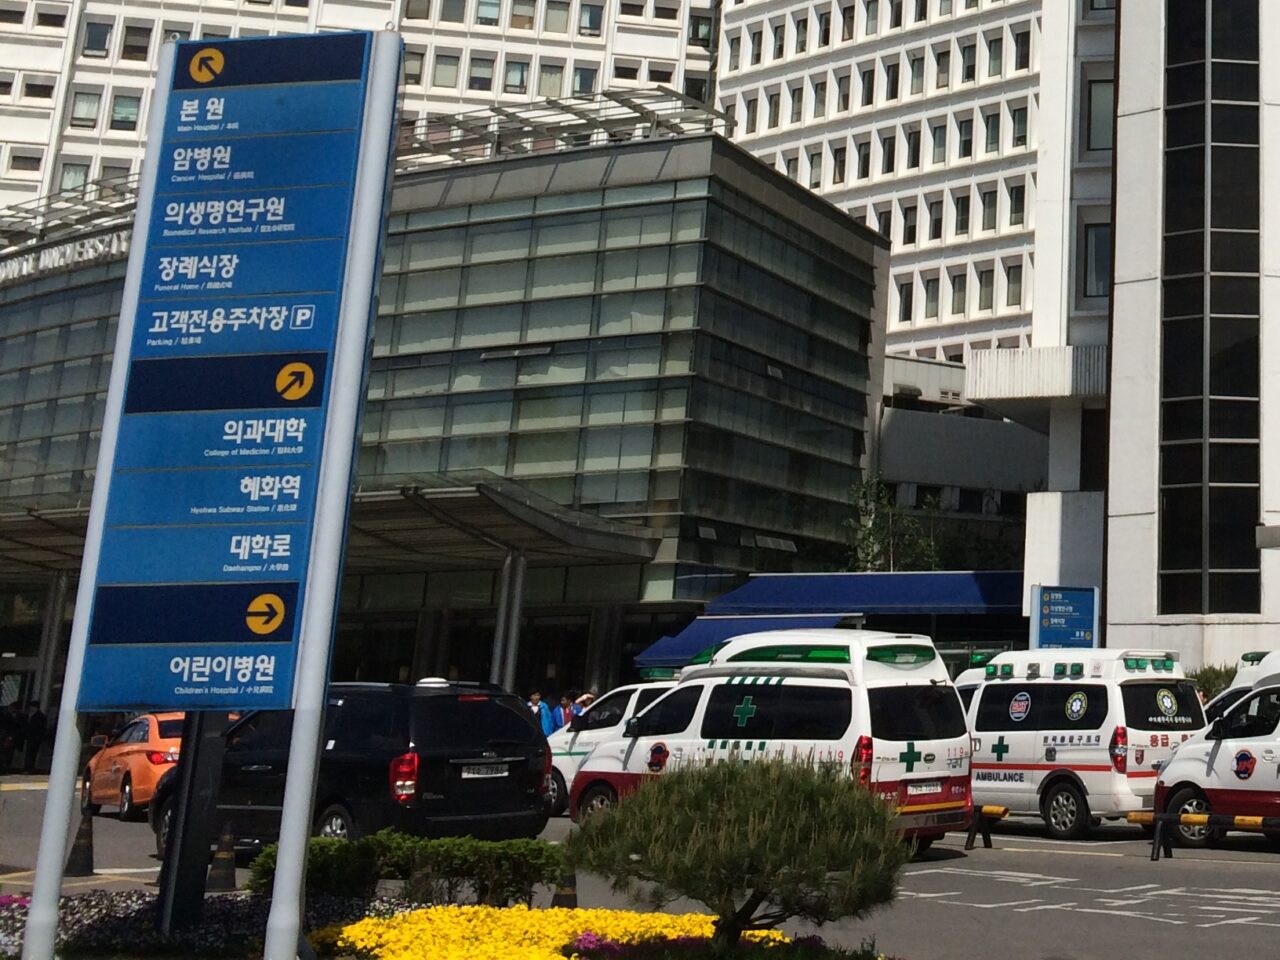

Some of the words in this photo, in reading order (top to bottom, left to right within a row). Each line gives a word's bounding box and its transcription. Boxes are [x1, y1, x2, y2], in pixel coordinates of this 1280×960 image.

[173, 145, 231, 171] 암병원
[198, 173, 226, 181] Hospital
[164, 197, 285, 226] 의생명연구원
[158, 254, 239, 281] 장례식장
[148, 306, 288, 333] 고객전용주차장
[222, 417, 307, 444] 의과대학
[204, 449, 230, 457] College
[231, 448, 238, 456] of
[240, 448, 270, 456] Medicine
[240, 475, 301, 501] 혜화역
[246, 505, 270, 513] Station
[229, 534, 291, 560] 대학로
[170, 654, 276, 683] 어린이병원
[210, 686, 239, 694] Hospital
[946, 747, 964, 757] 119
[976, 771, 1025, 783] AMBULANCE
